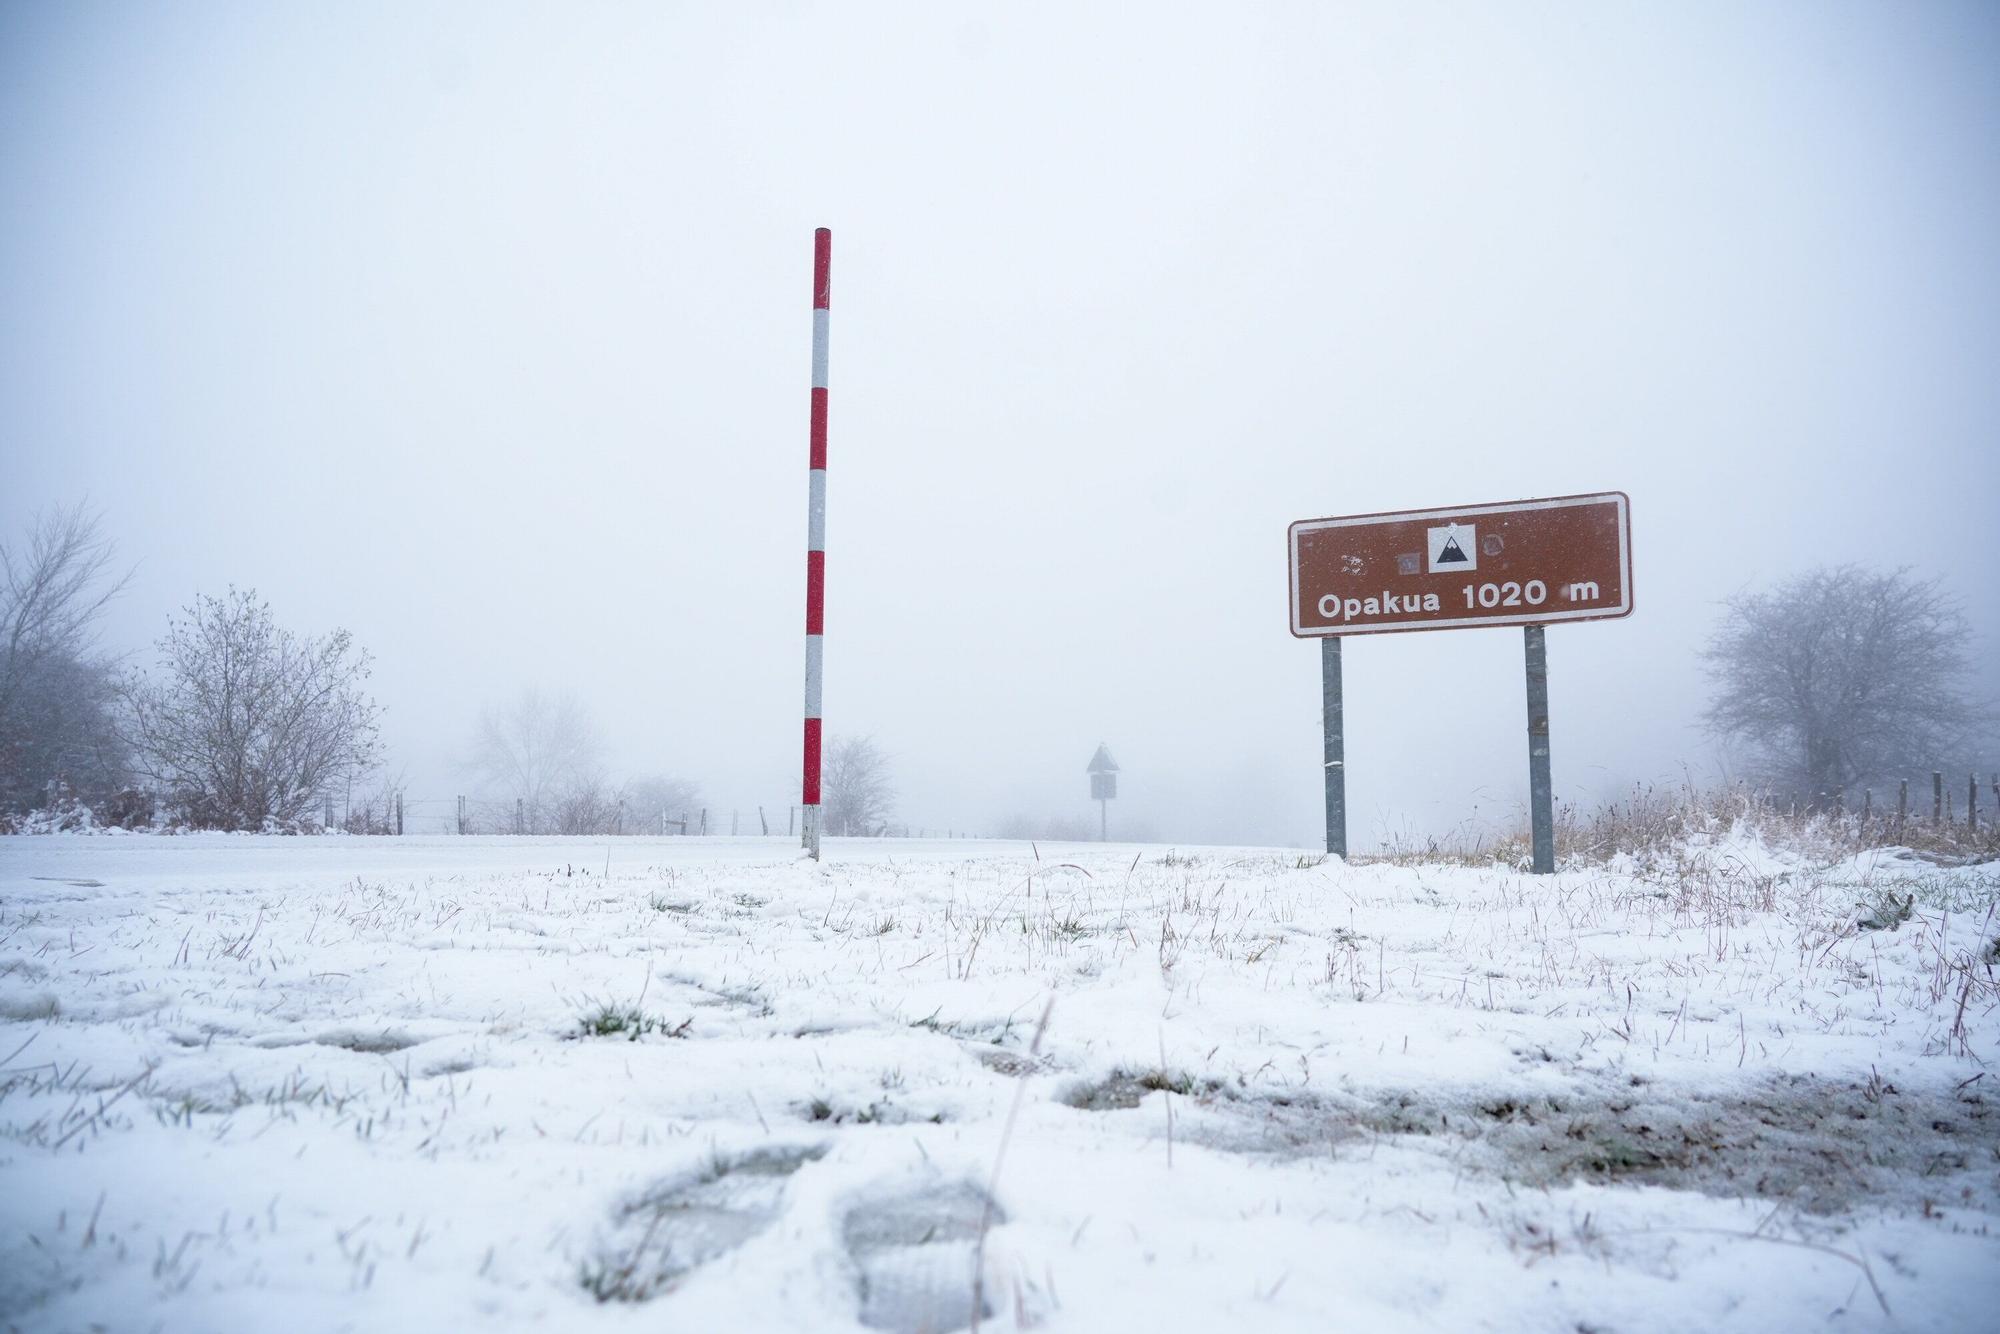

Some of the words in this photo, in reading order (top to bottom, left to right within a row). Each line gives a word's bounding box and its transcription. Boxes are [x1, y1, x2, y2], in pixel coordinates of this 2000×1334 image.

[1318, 590, 1441, 621] Opakua
[1462, 579, 1547, 609] 1020
[1570, 580, 1600, 602] m
